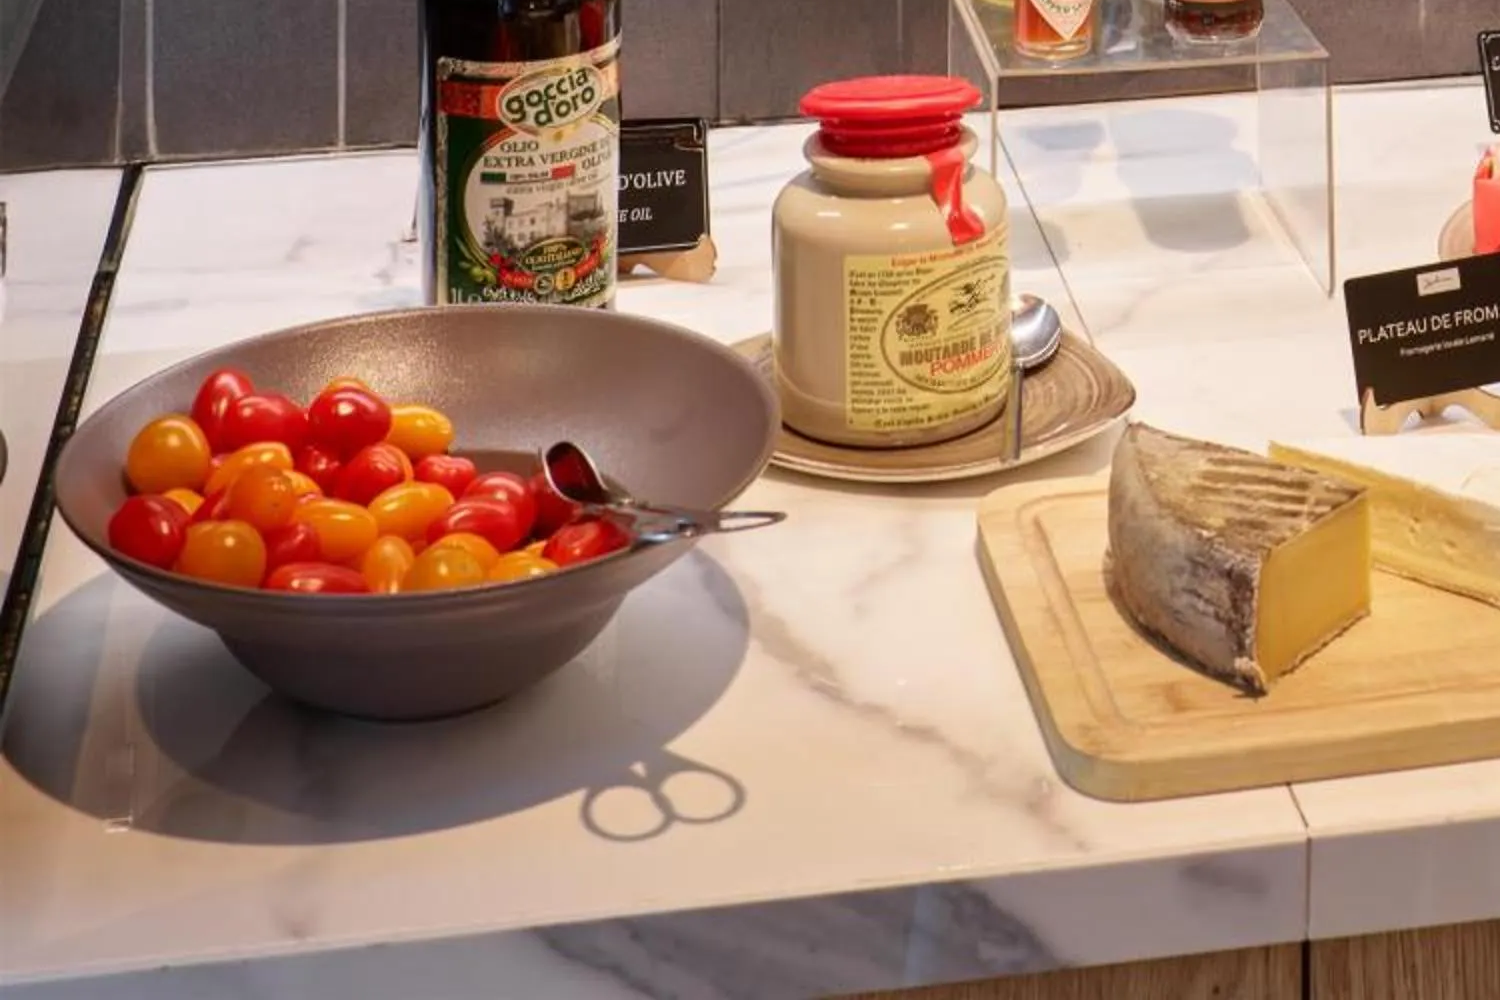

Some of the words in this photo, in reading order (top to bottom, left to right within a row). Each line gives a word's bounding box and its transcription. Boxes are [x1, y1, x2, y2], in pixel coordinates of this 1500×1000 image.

[505, 67, 588, 124] goccia
[483, 153, 535, 168] EXTRA
[631, 207, 653, 221] OIL
[1358, 318, 1428, 345] PLATEAU
[1431, 313, 1453, 331] DE
[900, 336, 976, 367] MOUTARDE
